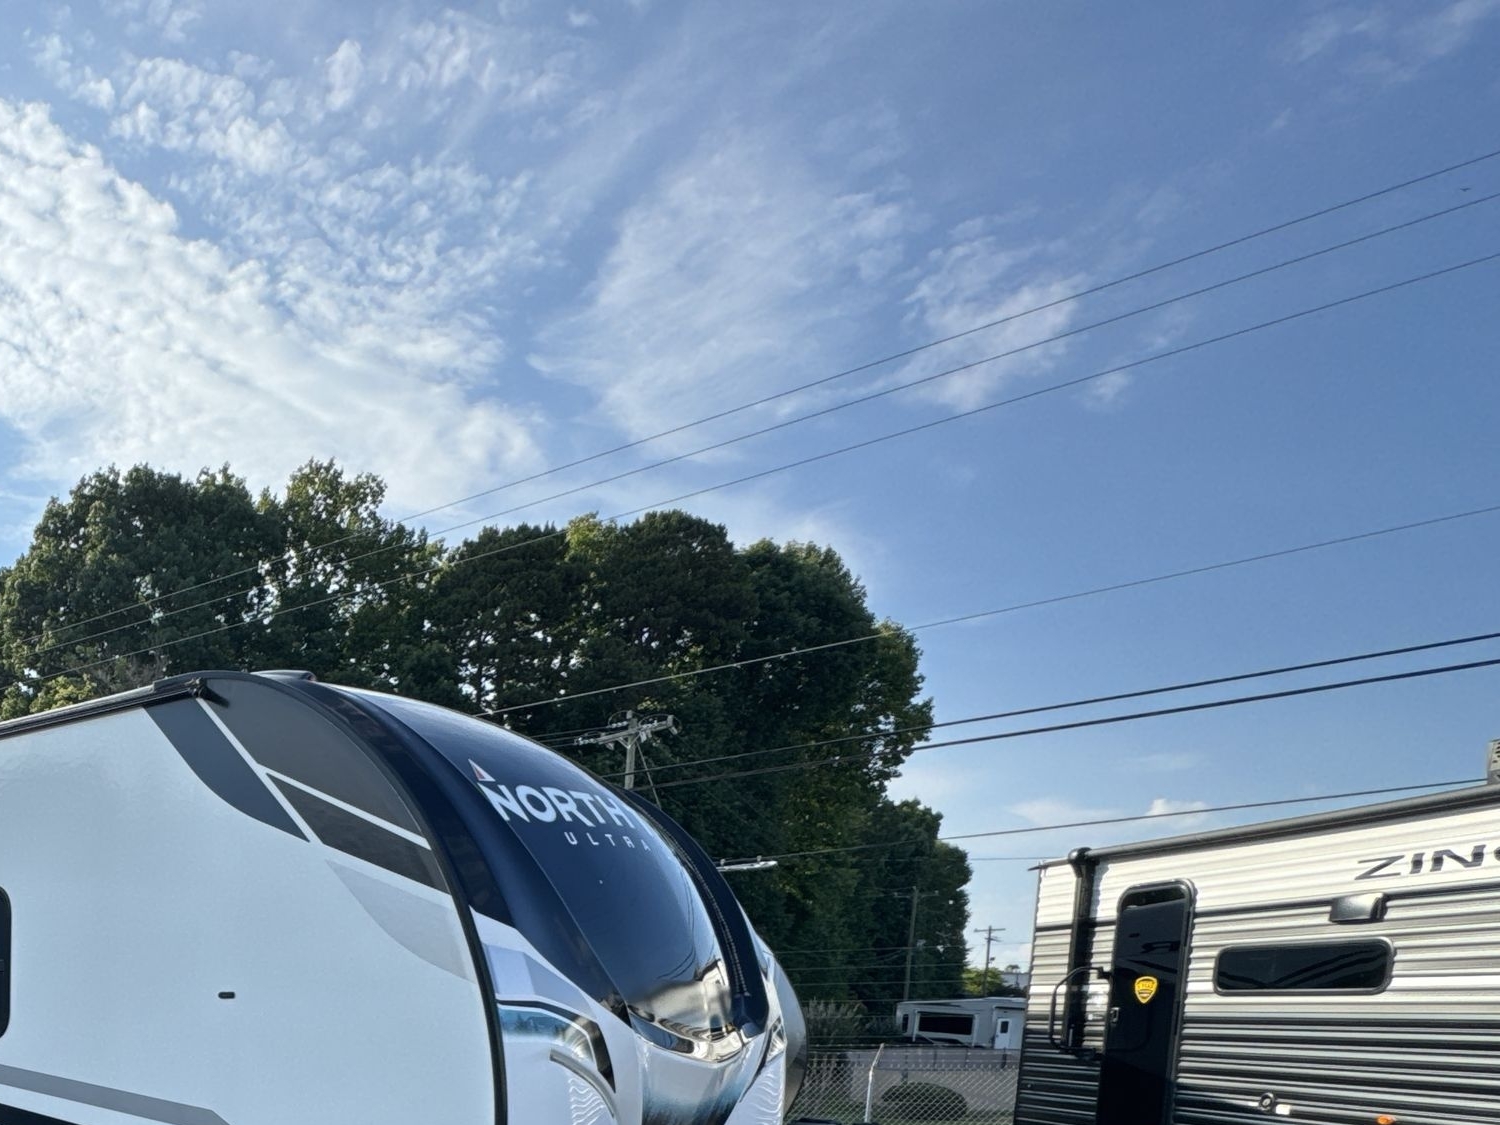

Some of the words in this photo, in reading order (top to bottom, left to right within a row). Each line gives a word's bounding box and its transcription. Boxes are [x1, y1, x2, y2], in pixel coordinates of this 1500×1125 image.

[477, 782, 636, 829] NORTH
[564, 831, 652, 851] ULTRA
[1354, 844, 1500, 880] ZIN
